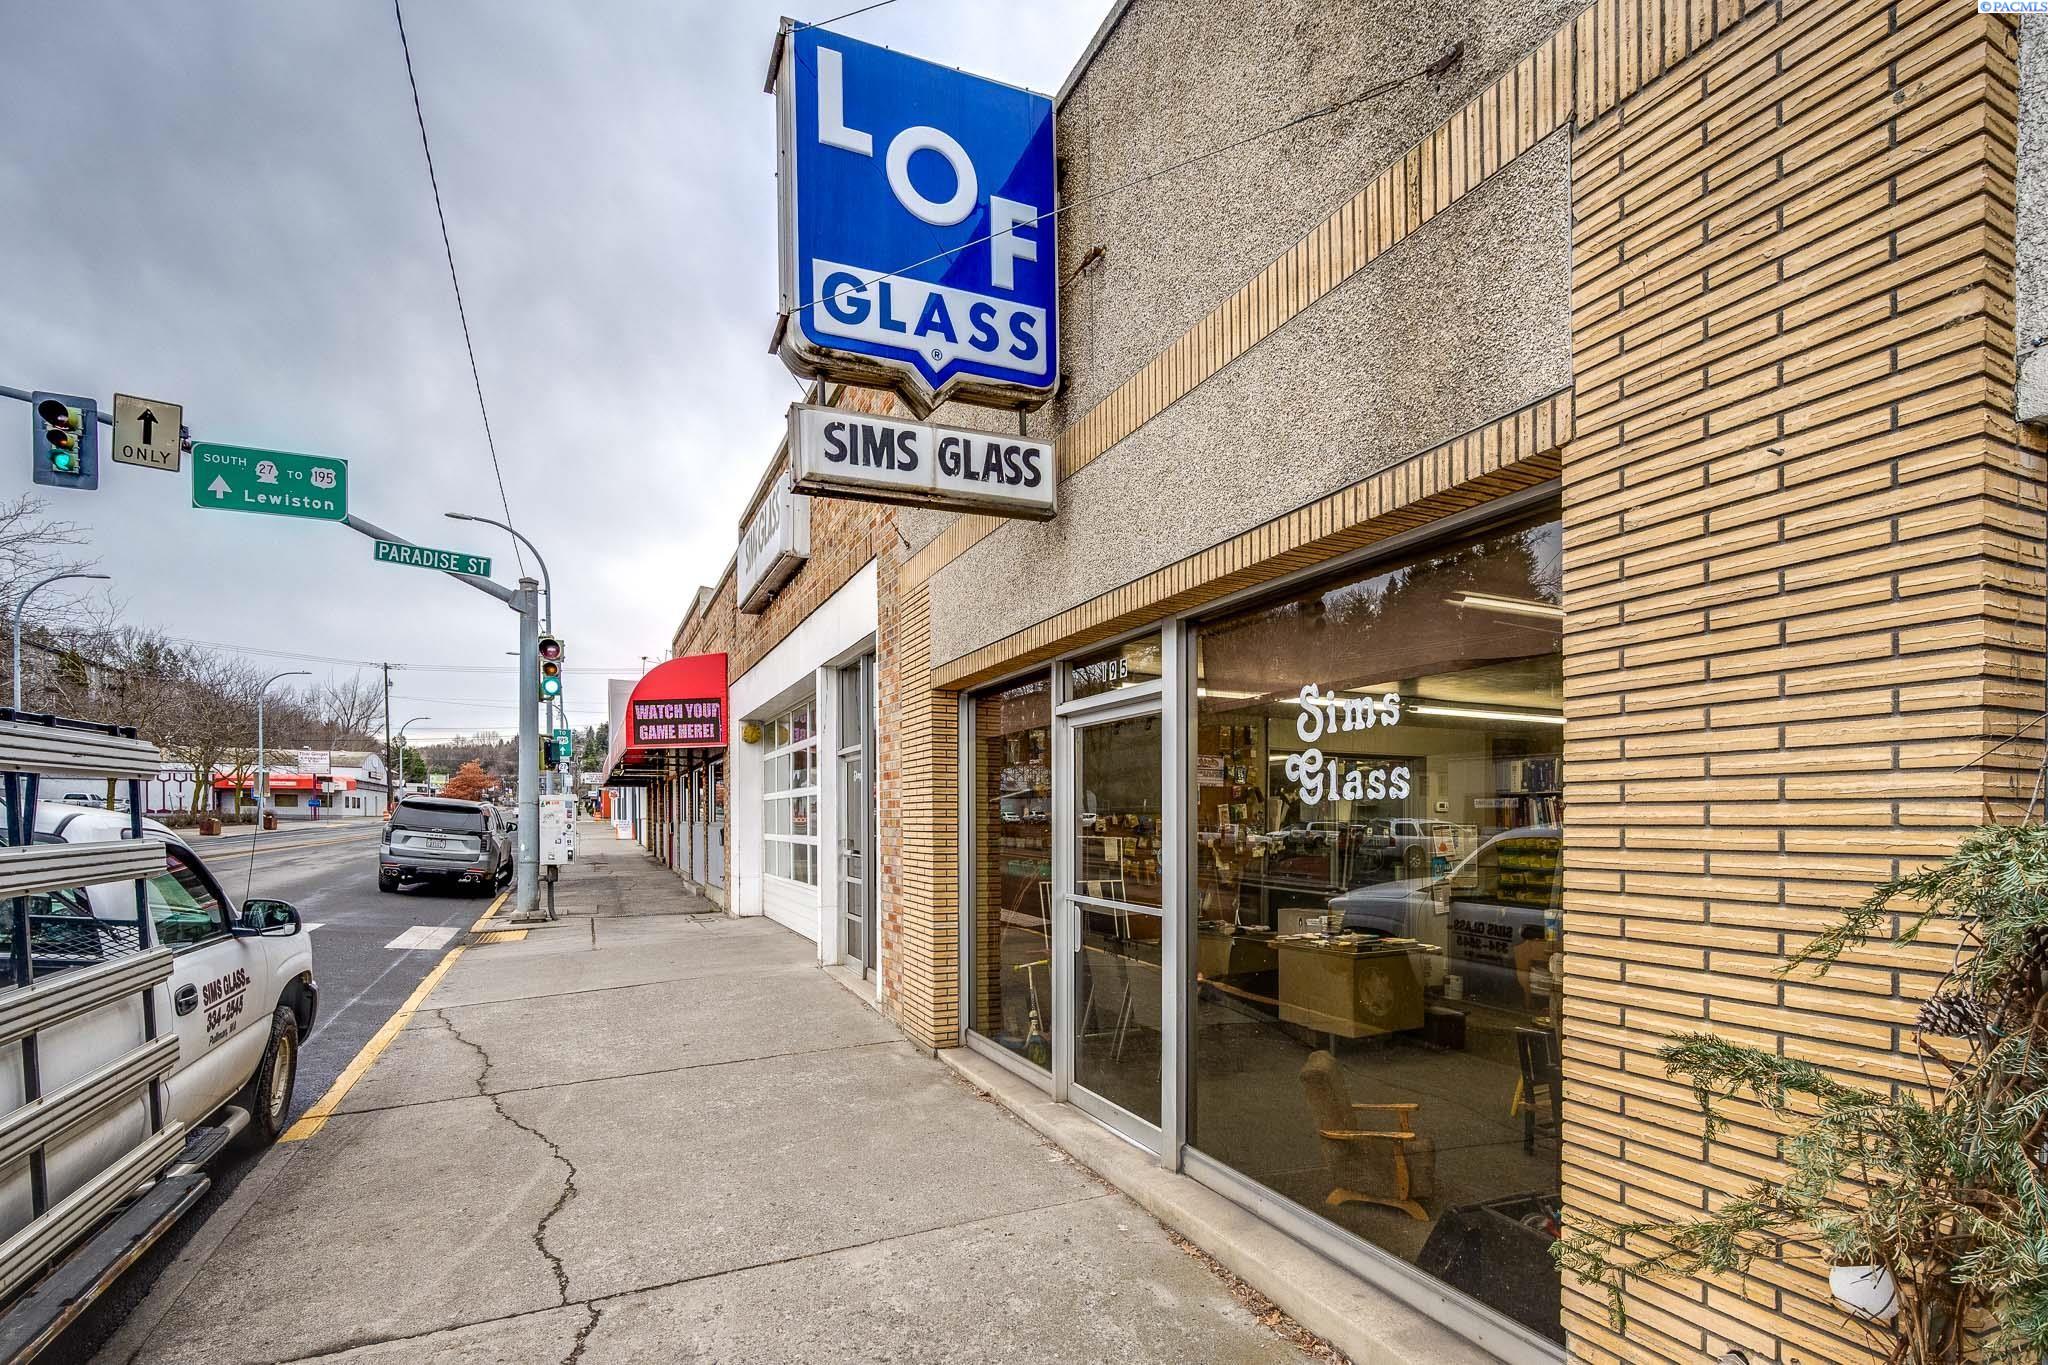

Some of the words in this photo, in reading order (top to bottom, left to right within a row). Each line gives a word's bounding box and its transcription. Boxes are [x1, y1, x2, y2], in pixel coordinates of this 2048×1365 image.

[815, 44, 1039, 293] LOF
[821, 271, 1040, 362] GLASS
[122, 445, 171, 464] ONLY
[203, 453, 247, 466] SOUTH
[258, 463, 274, 475] 27
[287, 470, 303, 480] TO
[314, 470, 333, 485] 195
[823, 420, 919, 472] SIMS
[937, 436, 1042, 488] GLASS
[244, 489, 335, 511] Lewiston
[378, 543, 460, 571] PARADISE
[467, 557, 488, 575] ST
[1103, 659, 1127, 681] 195
[634, 703, 683, 720] WATCH
[1296, 682, 1401, 743] Sims
[639, 724, 677, 741] GAME
[677, 723, 715, 739] HERE!
[1284, 747, 1411, 806] Glass
[202, 978, 223, 1007] SIMS
[223, 967, 246, 996] GLASS
